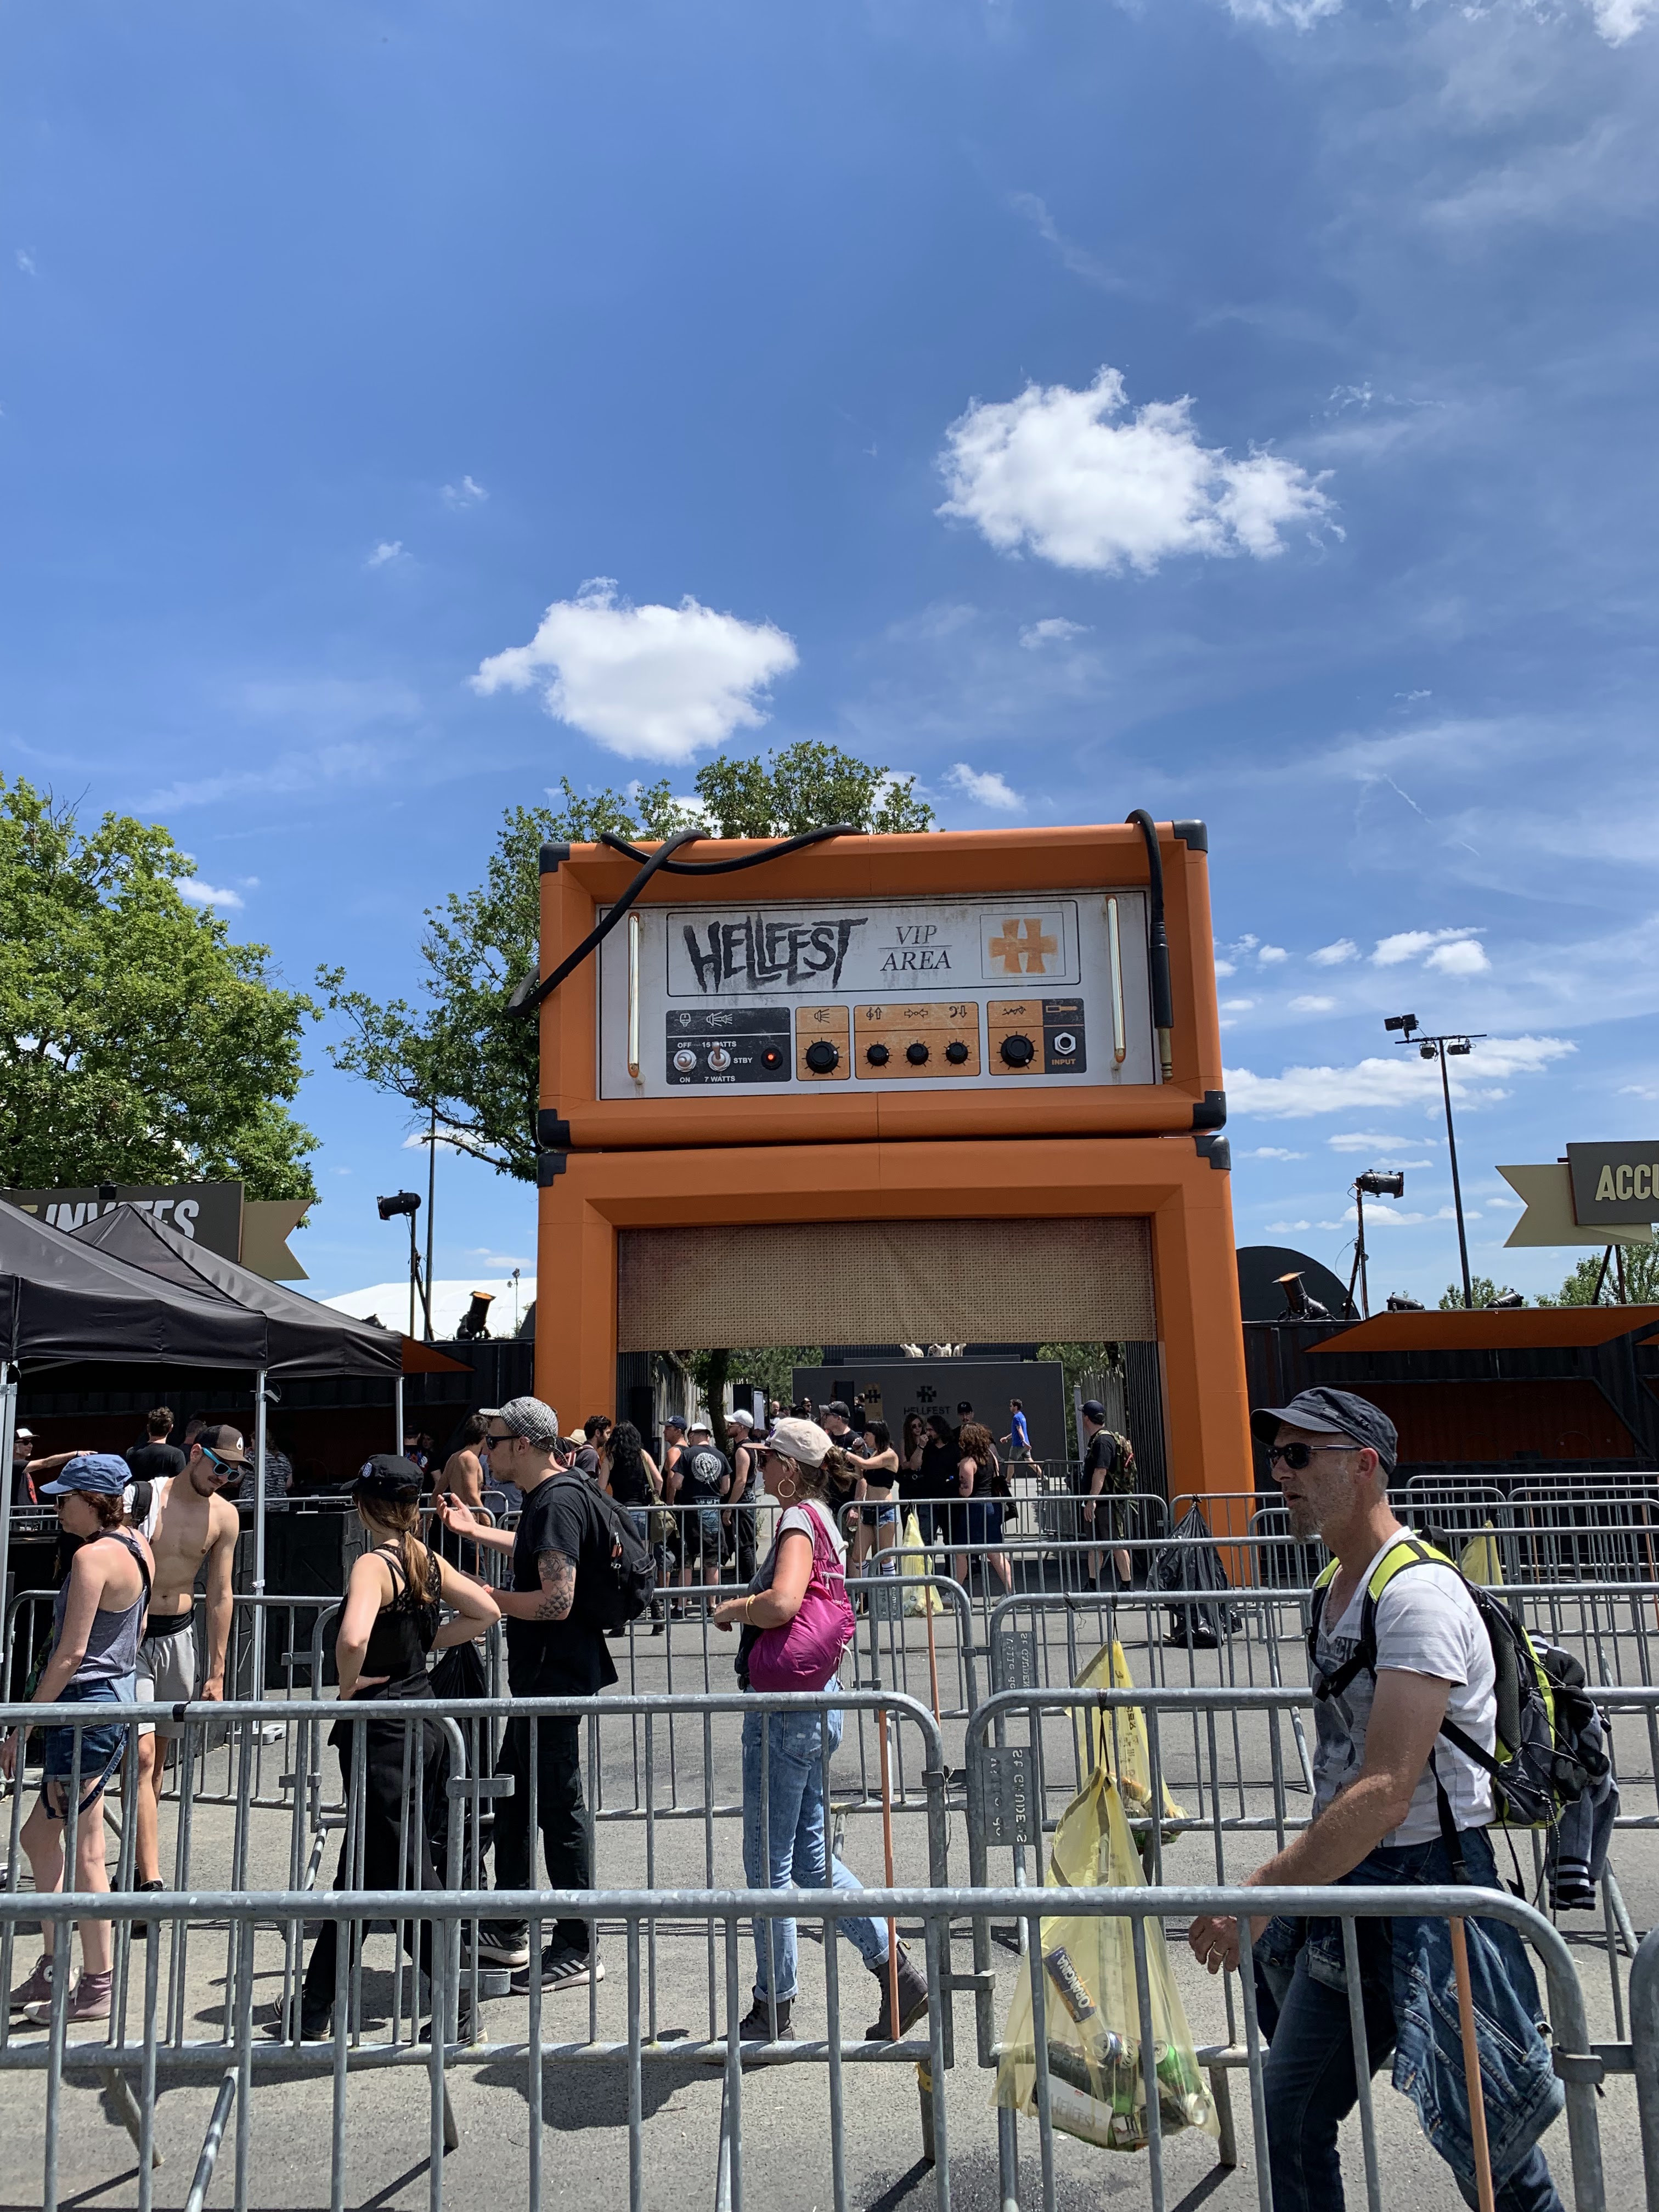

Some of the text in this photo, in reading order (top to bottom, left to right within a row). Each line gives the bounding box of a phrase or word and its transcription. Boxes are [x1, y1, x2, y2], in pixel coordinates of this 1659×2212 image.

[895, 925, 938, 945] VIP
[683, 912, 868, 993] HELLFEST
[880, 950, 952, 972] AREA
[904, 1406, 951, 1415] HELLFEST
[1057, 1954, 1091, 2008] ORANGINA
